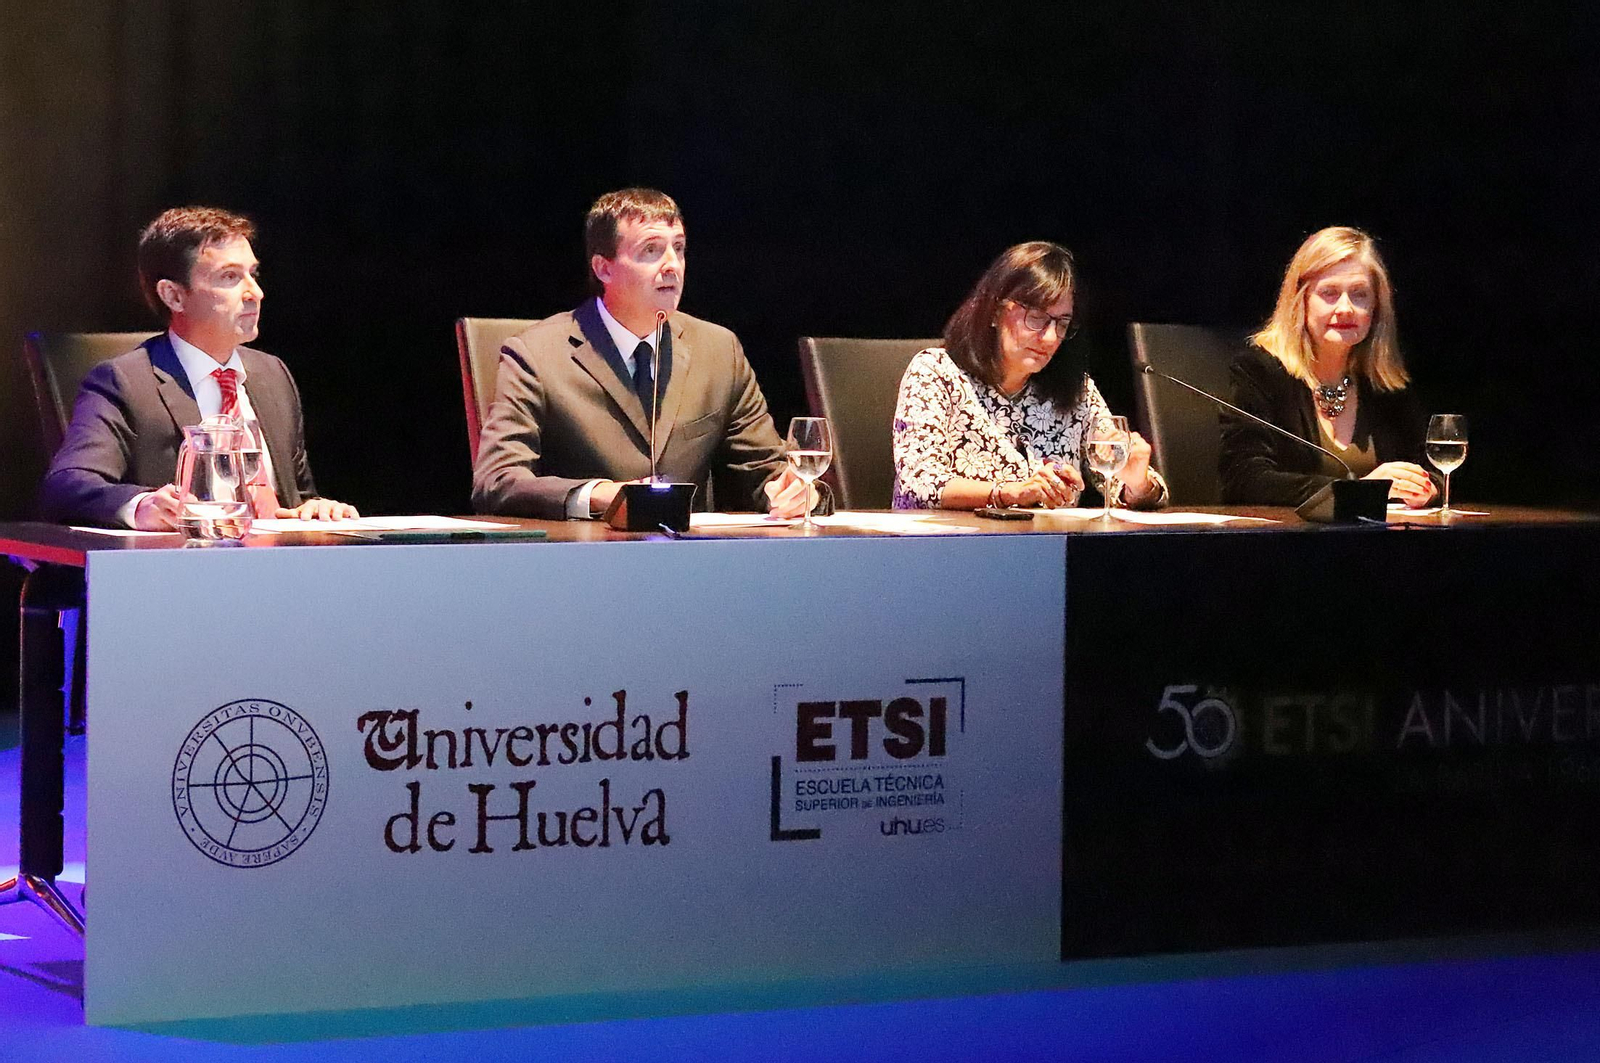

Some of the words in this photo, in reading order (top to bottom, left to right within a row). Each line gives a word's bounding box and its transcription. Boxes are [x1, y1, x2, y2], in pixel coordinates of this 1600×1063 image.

[357, 689, 691, 772] Universidad
[796, 697, 947, 763] ETSI
[1146, 684, 1236, 760] 50
[1263, 694, 1375, 755] ETSI
[384, 780, 457, 854] de
[468, 777, 672, 854] Huelva
[795, 797, 859, 812] SUPERIOR
[875, 792, 945, 808] INGENIERÍA
[796, 778, 871, 796] ESCUELA
[875, 773, 945, 792] TÉCNICA
